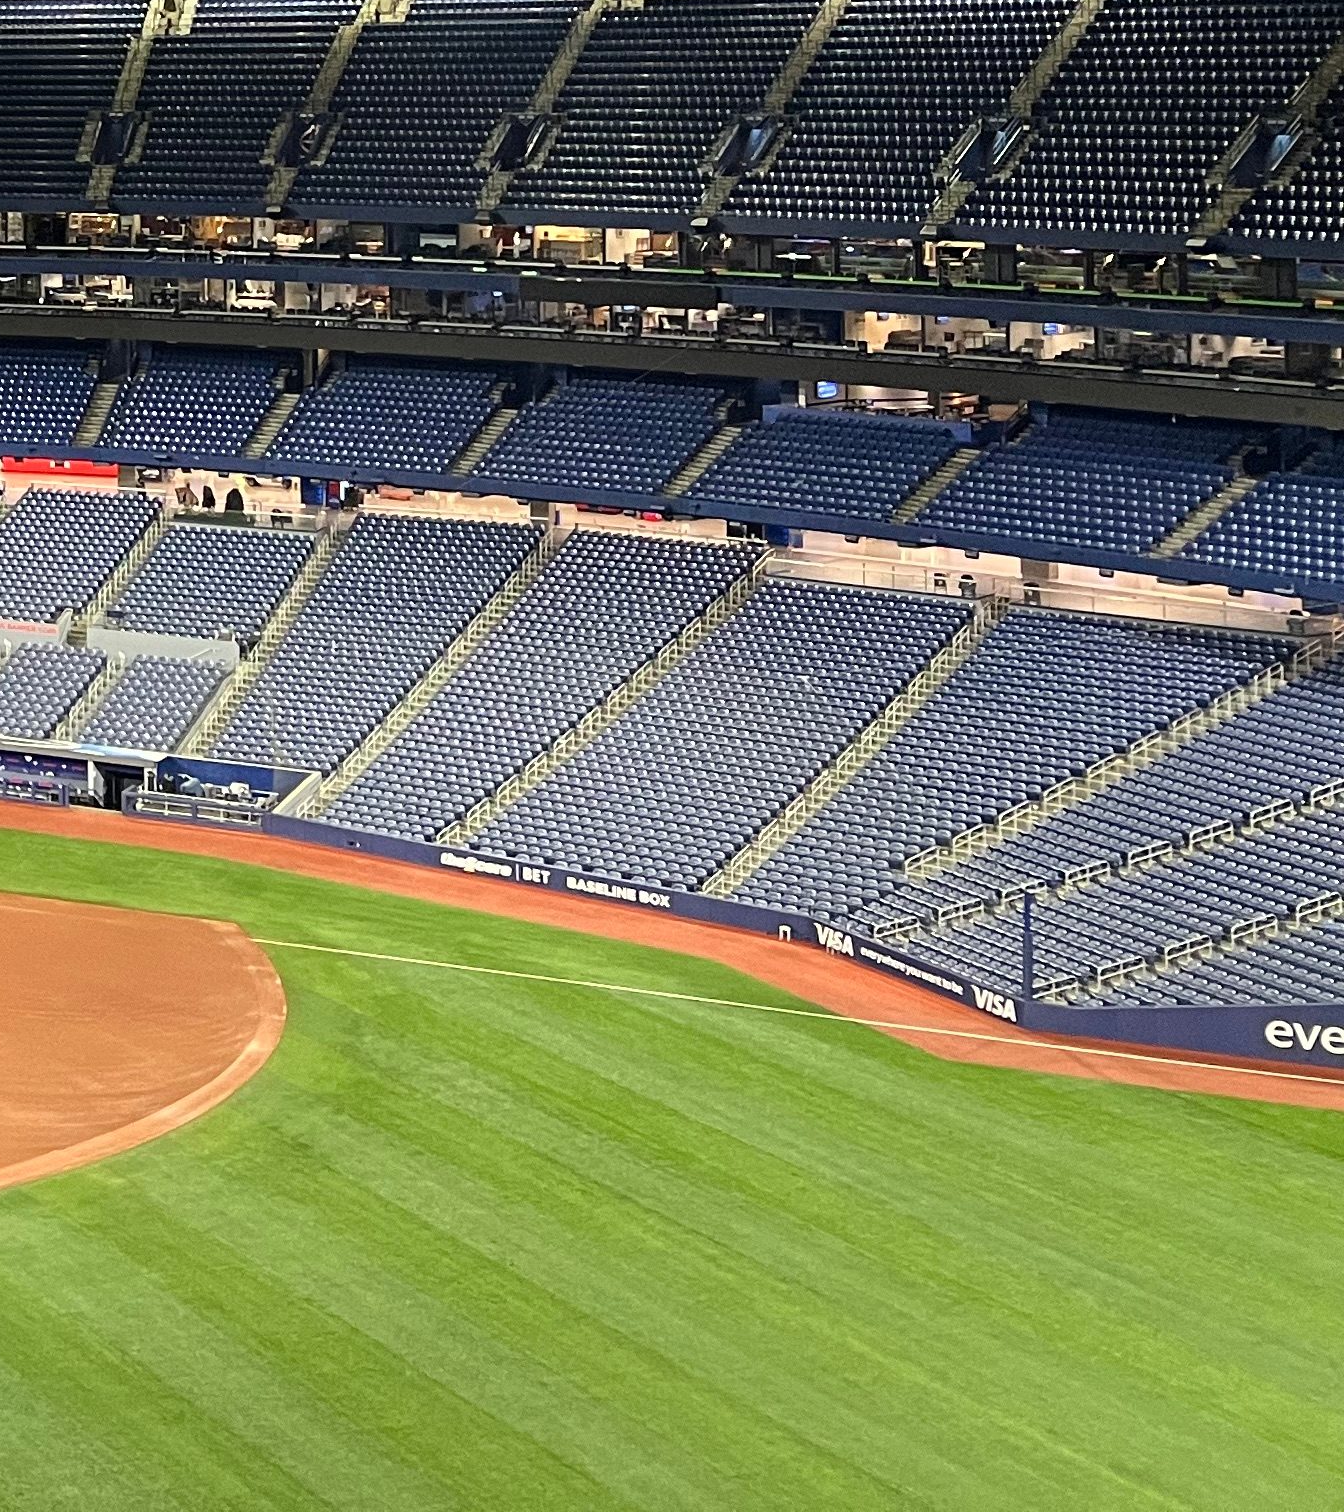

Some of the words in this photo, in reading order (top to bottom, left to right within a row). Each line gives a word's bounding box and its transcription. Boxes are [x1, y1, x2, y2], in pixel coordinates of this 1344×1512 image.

[523, 867, 551, 885] BET
[566, 876, 637, 902] BASELINE
[639, 889, 671, 908] BOX
[813, 922, 855, 957] VISA
[971, 984, 1018, 1023] VISA
[1265, 1020, 1344, 1055] eve
